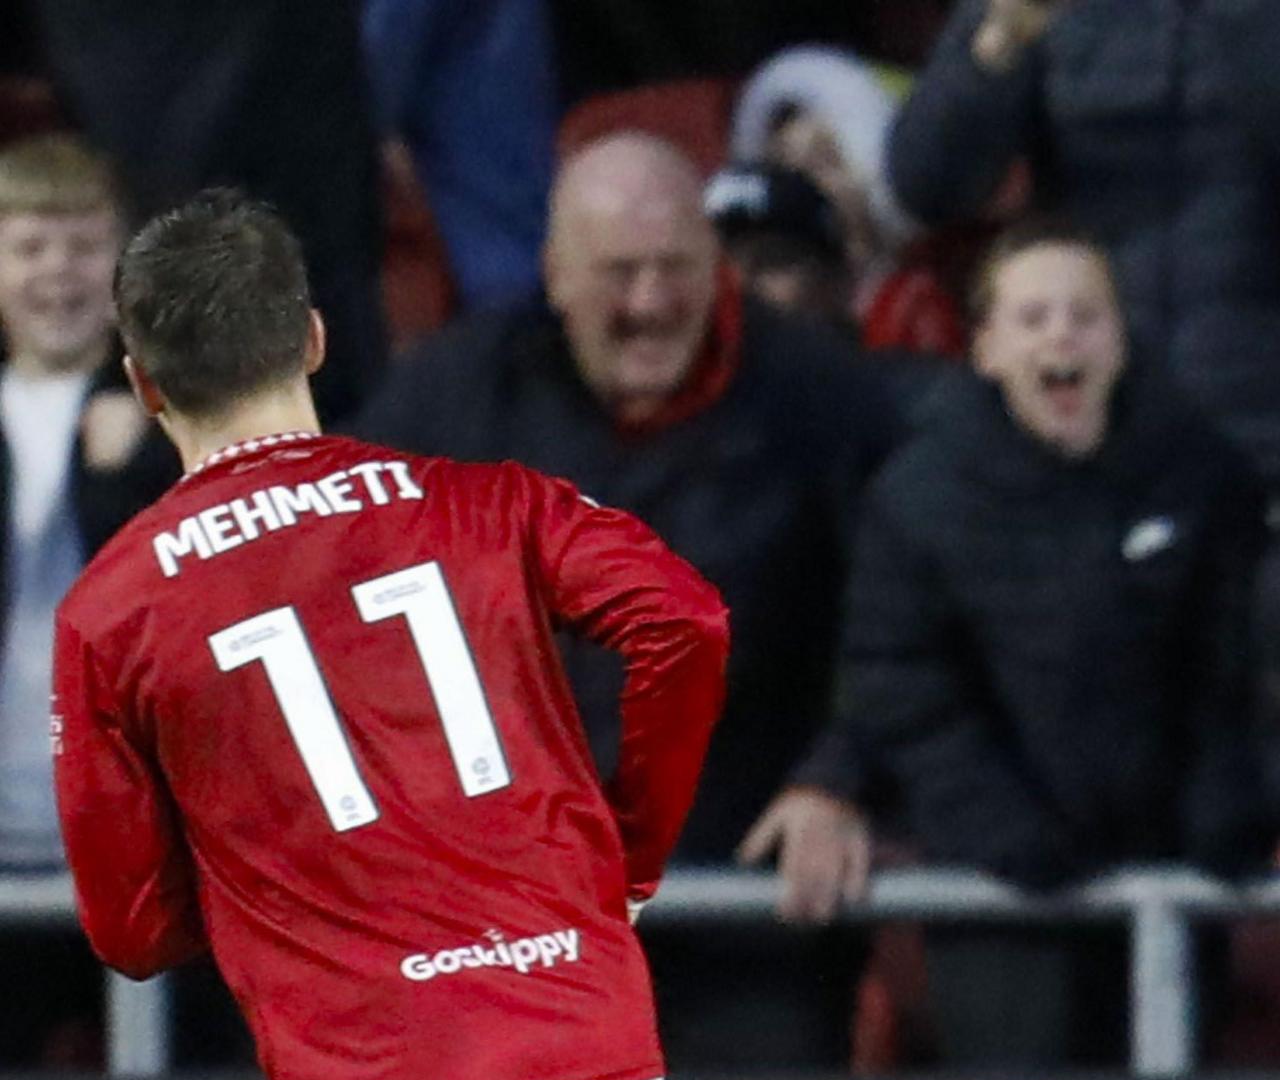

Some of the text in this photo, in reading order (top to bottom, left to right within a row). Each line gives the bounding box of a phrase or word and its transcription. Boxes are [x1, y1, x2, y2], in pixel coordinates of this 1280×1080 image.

[152, 461, 424, 578] MEHMETI
[207, 560, 513, 833] 11
[400, 929, 578, 981] Goskippy
